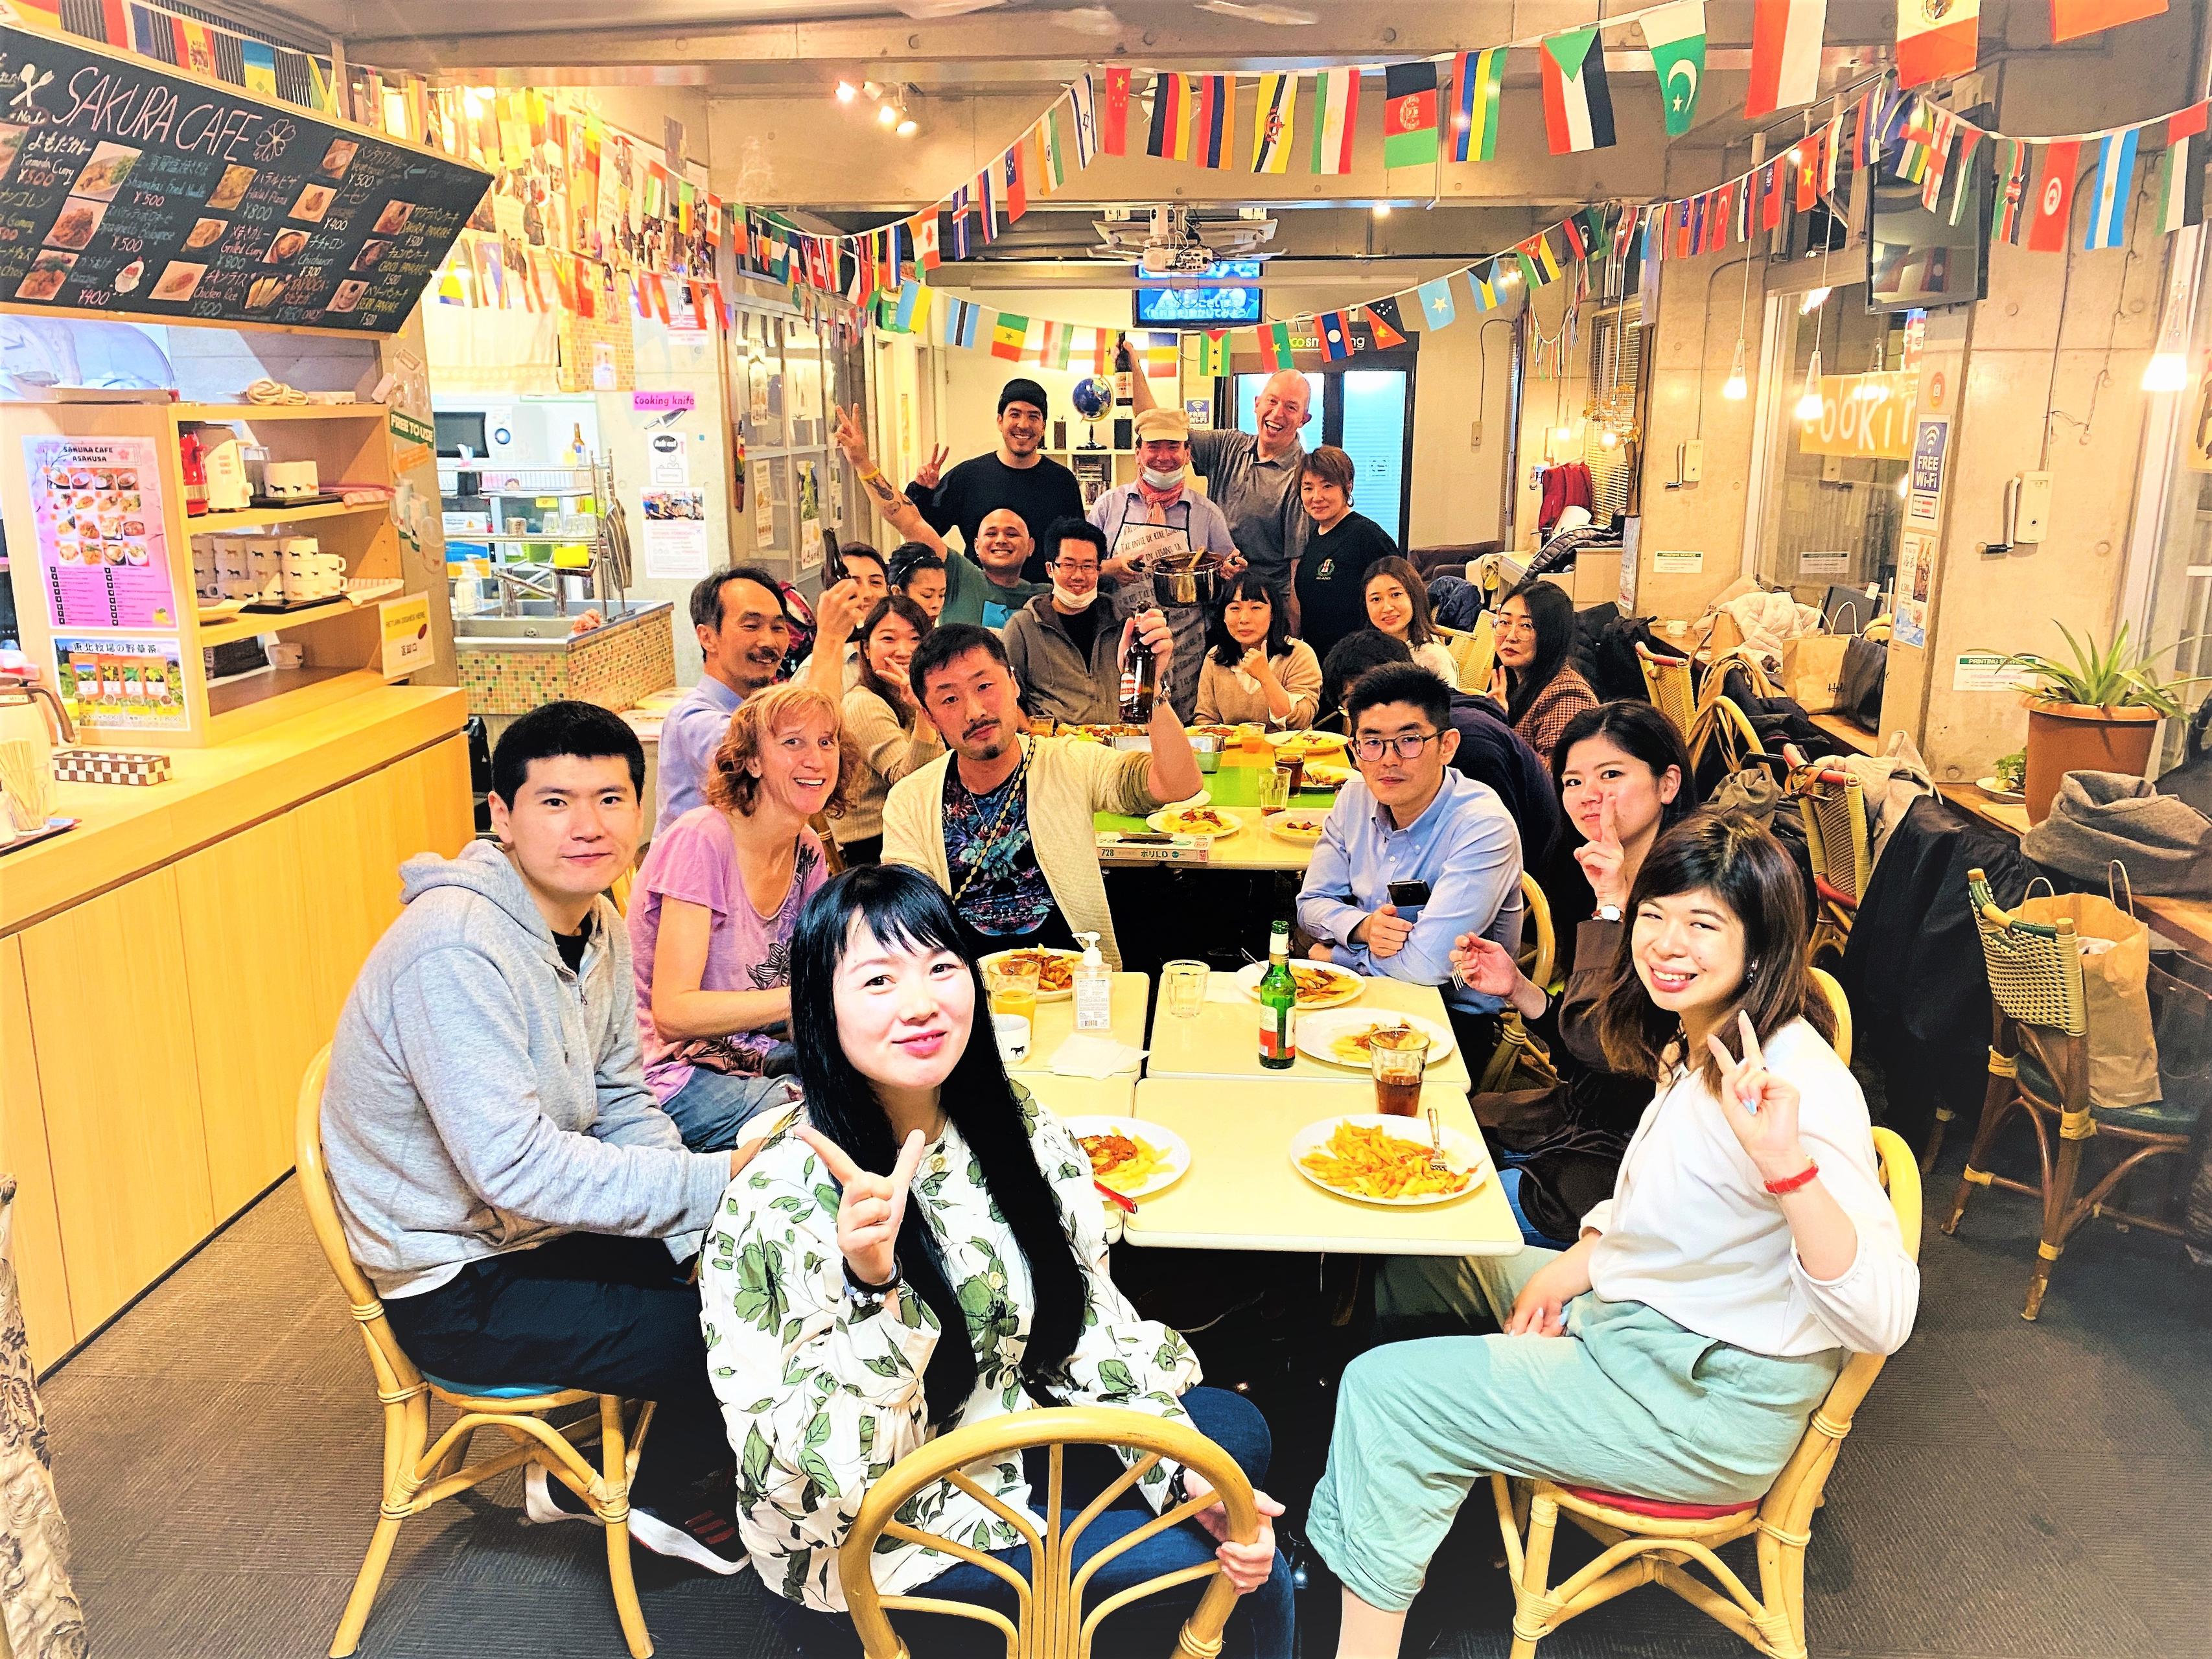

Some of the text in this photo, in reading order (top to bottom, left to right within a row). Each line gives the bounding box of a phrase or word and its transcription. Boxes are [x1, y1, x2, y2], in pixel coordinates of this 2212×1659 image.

[52, 66, 262, 162] SAKURA CAFE
[349, 173, 374, 187] ¥500
[133, 191, 165, 207] ¥500
[242, 202, 273, 221] ¥800
[323, 217, 348, 231] ¥400
[110, 234, 143, 253] ¥500
[406, 235, 425, 247] ¥500
[634, 395, 695, 406] Cooking knife
[391, 413, 434, 443] FREE TO USE
[1917, 455, 1940, 471] FREE
[1916, 470, 1938, 489] Wi-Fi
[1146, 534, 1153, 543] DE
